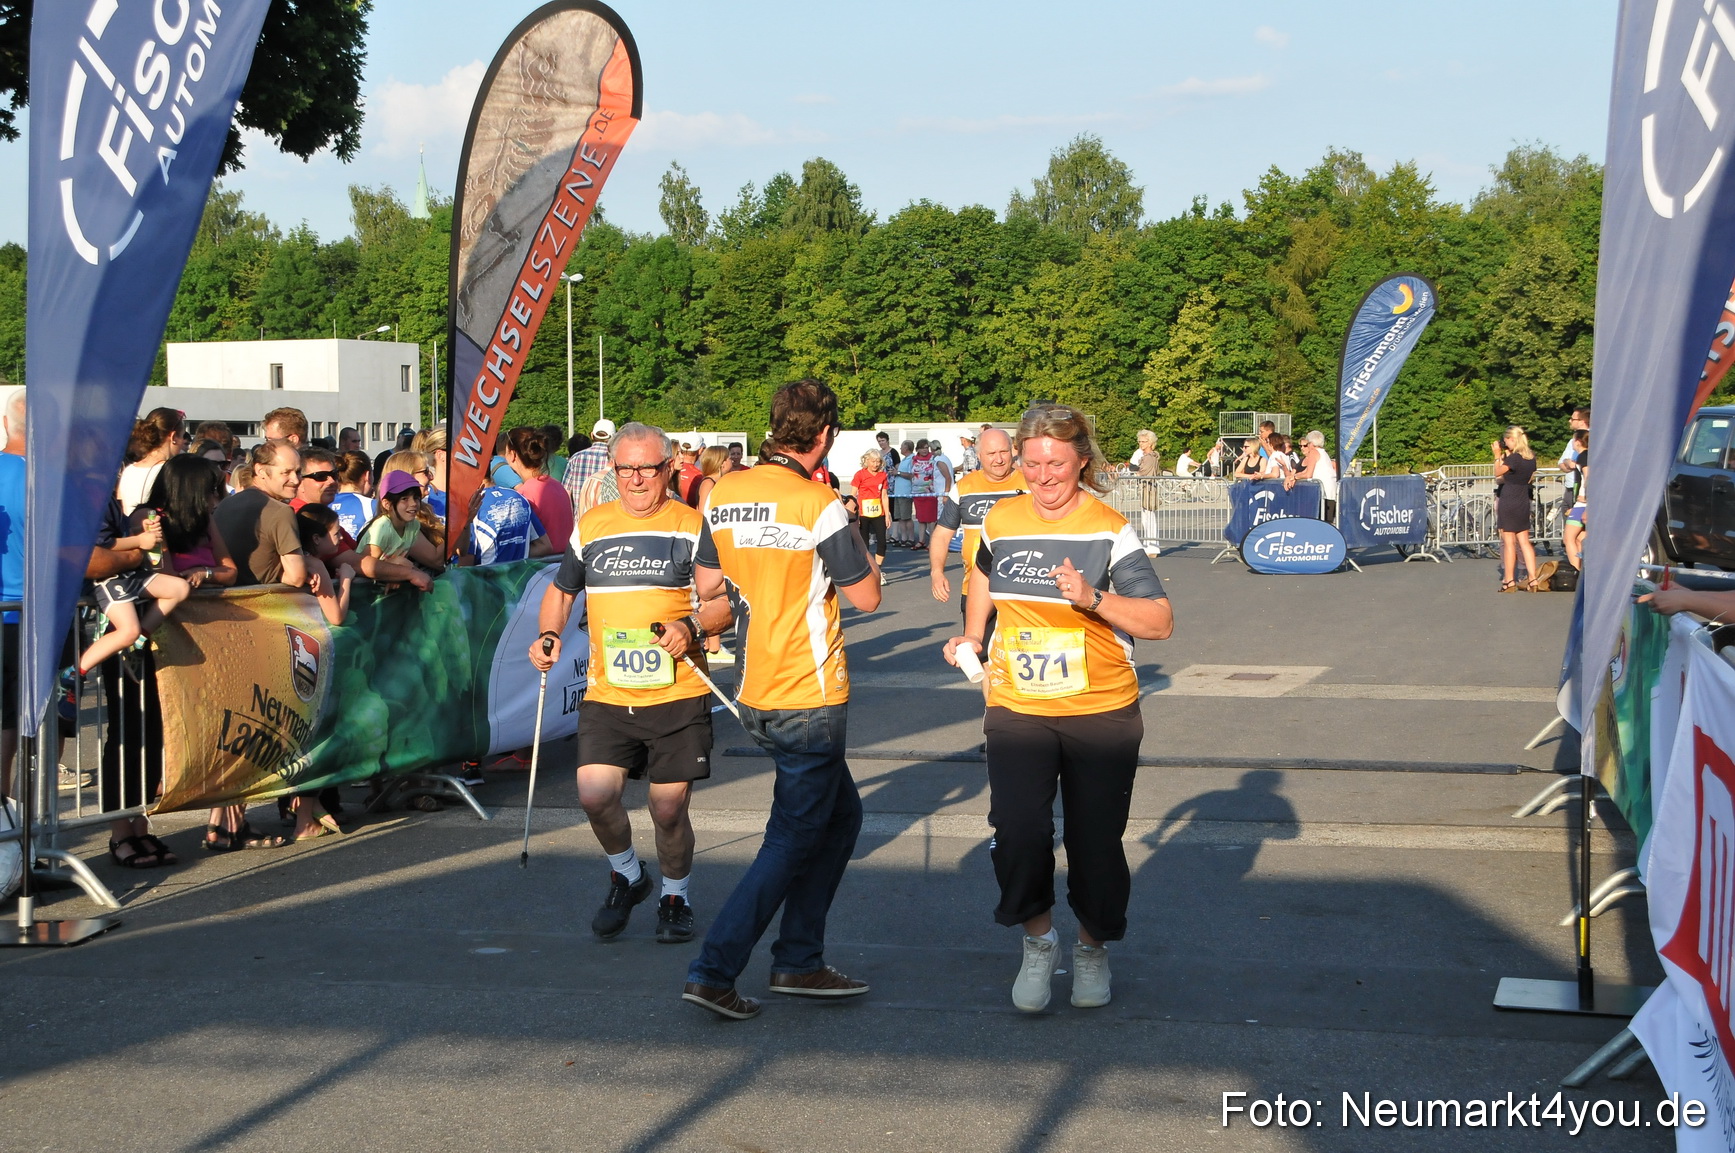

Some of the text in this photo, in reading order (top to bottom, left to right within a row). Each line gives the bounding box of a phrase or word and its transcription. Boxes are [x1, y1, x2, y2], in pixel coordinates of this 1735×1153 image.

[1345, 316, 1409, 401] Frischmann
[710, 502, 770, 525] Benzin
[866, 505, 879, 513] 144
[1369, 505, 1413, 525] Fischer
[756, 525, 807, 550] Blut
[1373, 526, 1410, 536] AUTOMOBILE
[1268, 541, 1334, 556] Fischer
[1274, 554, 1329, 562] AUTOMOBILE
[603, 556, 670, 569] Fischer
[613, 649, 661, 674] 409
[1016, 652, 1069, 682] 371
